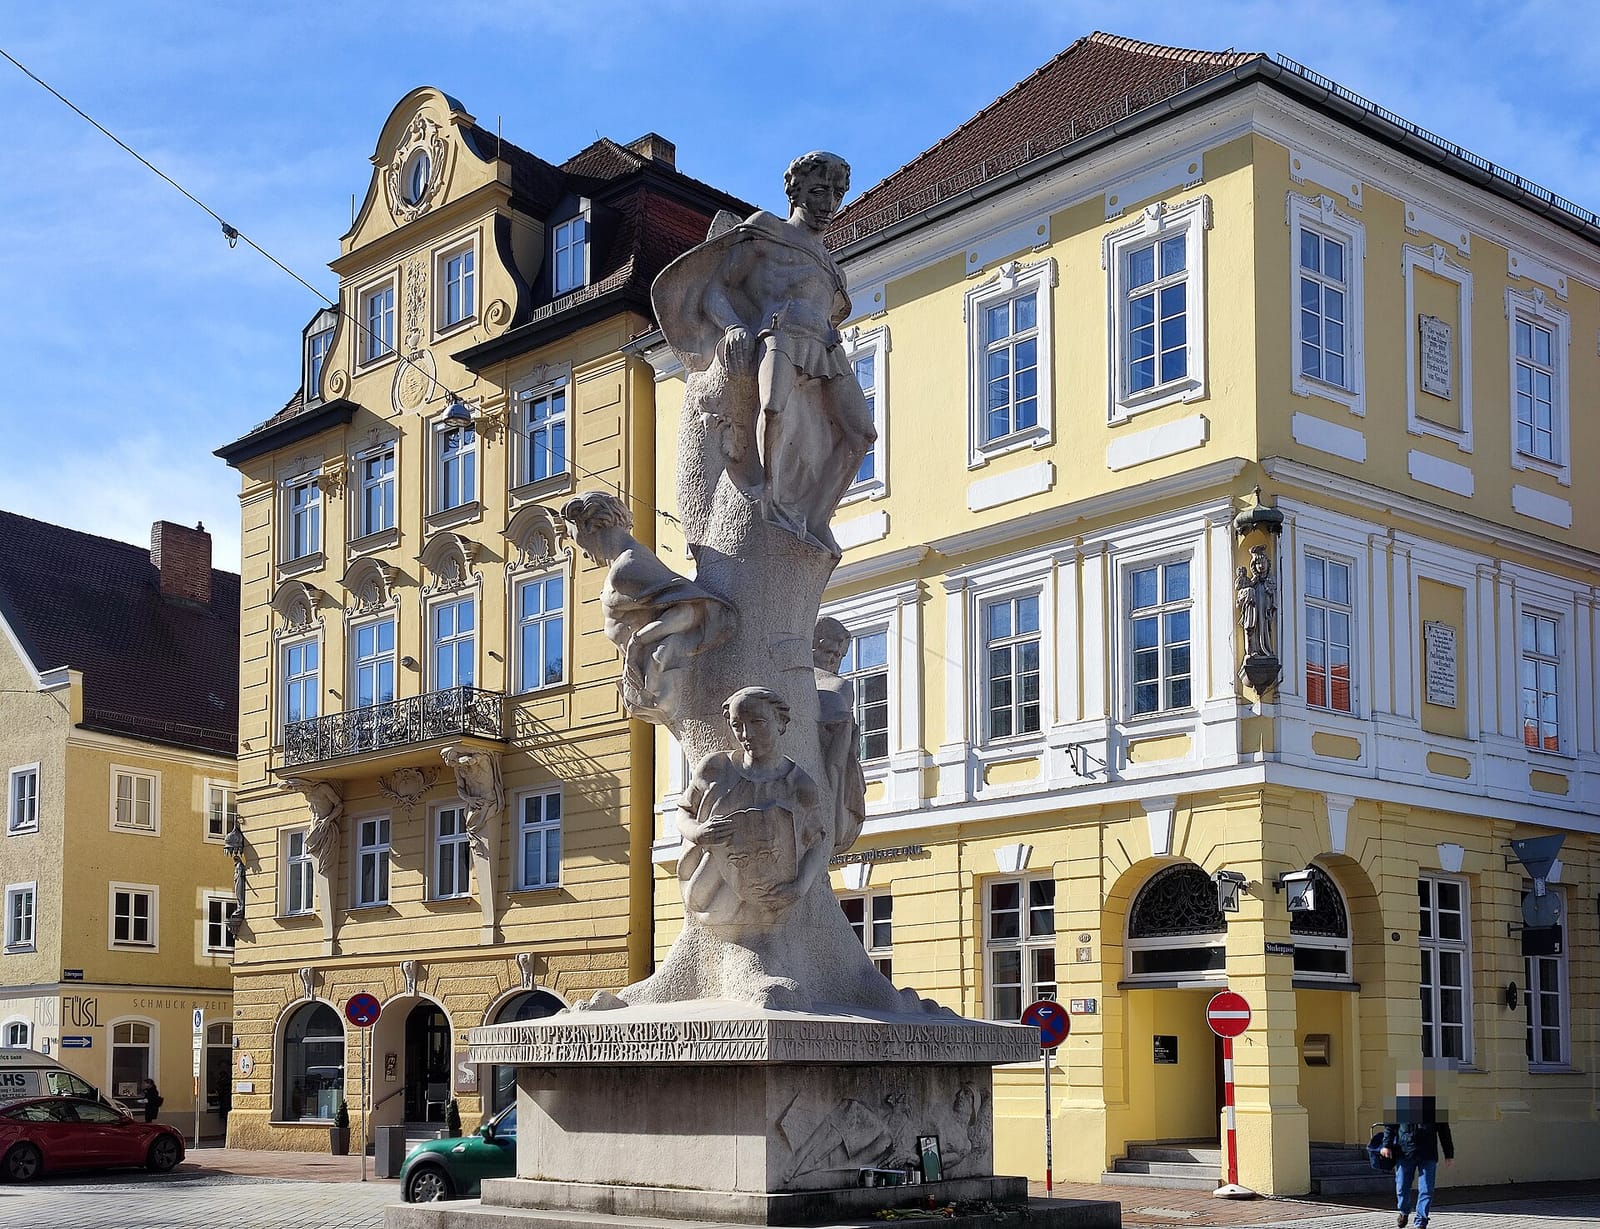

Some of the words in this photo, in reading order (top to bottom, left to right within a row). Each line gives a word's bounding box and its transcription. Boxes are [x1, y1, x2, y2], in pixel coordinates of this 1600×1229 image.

[133, 998, 186, 1009] SCHMUCK
[204, 1001, 229, 1011] ZEIT
[511, 1026, 537, 1044] DEN
[594, 1024, 623, 1043] DER
[625, 1022, 678, 1042] KRIEGE
[682, 1021, 713, 1041] UND
[905, 1024, 930, 1042] DAS
